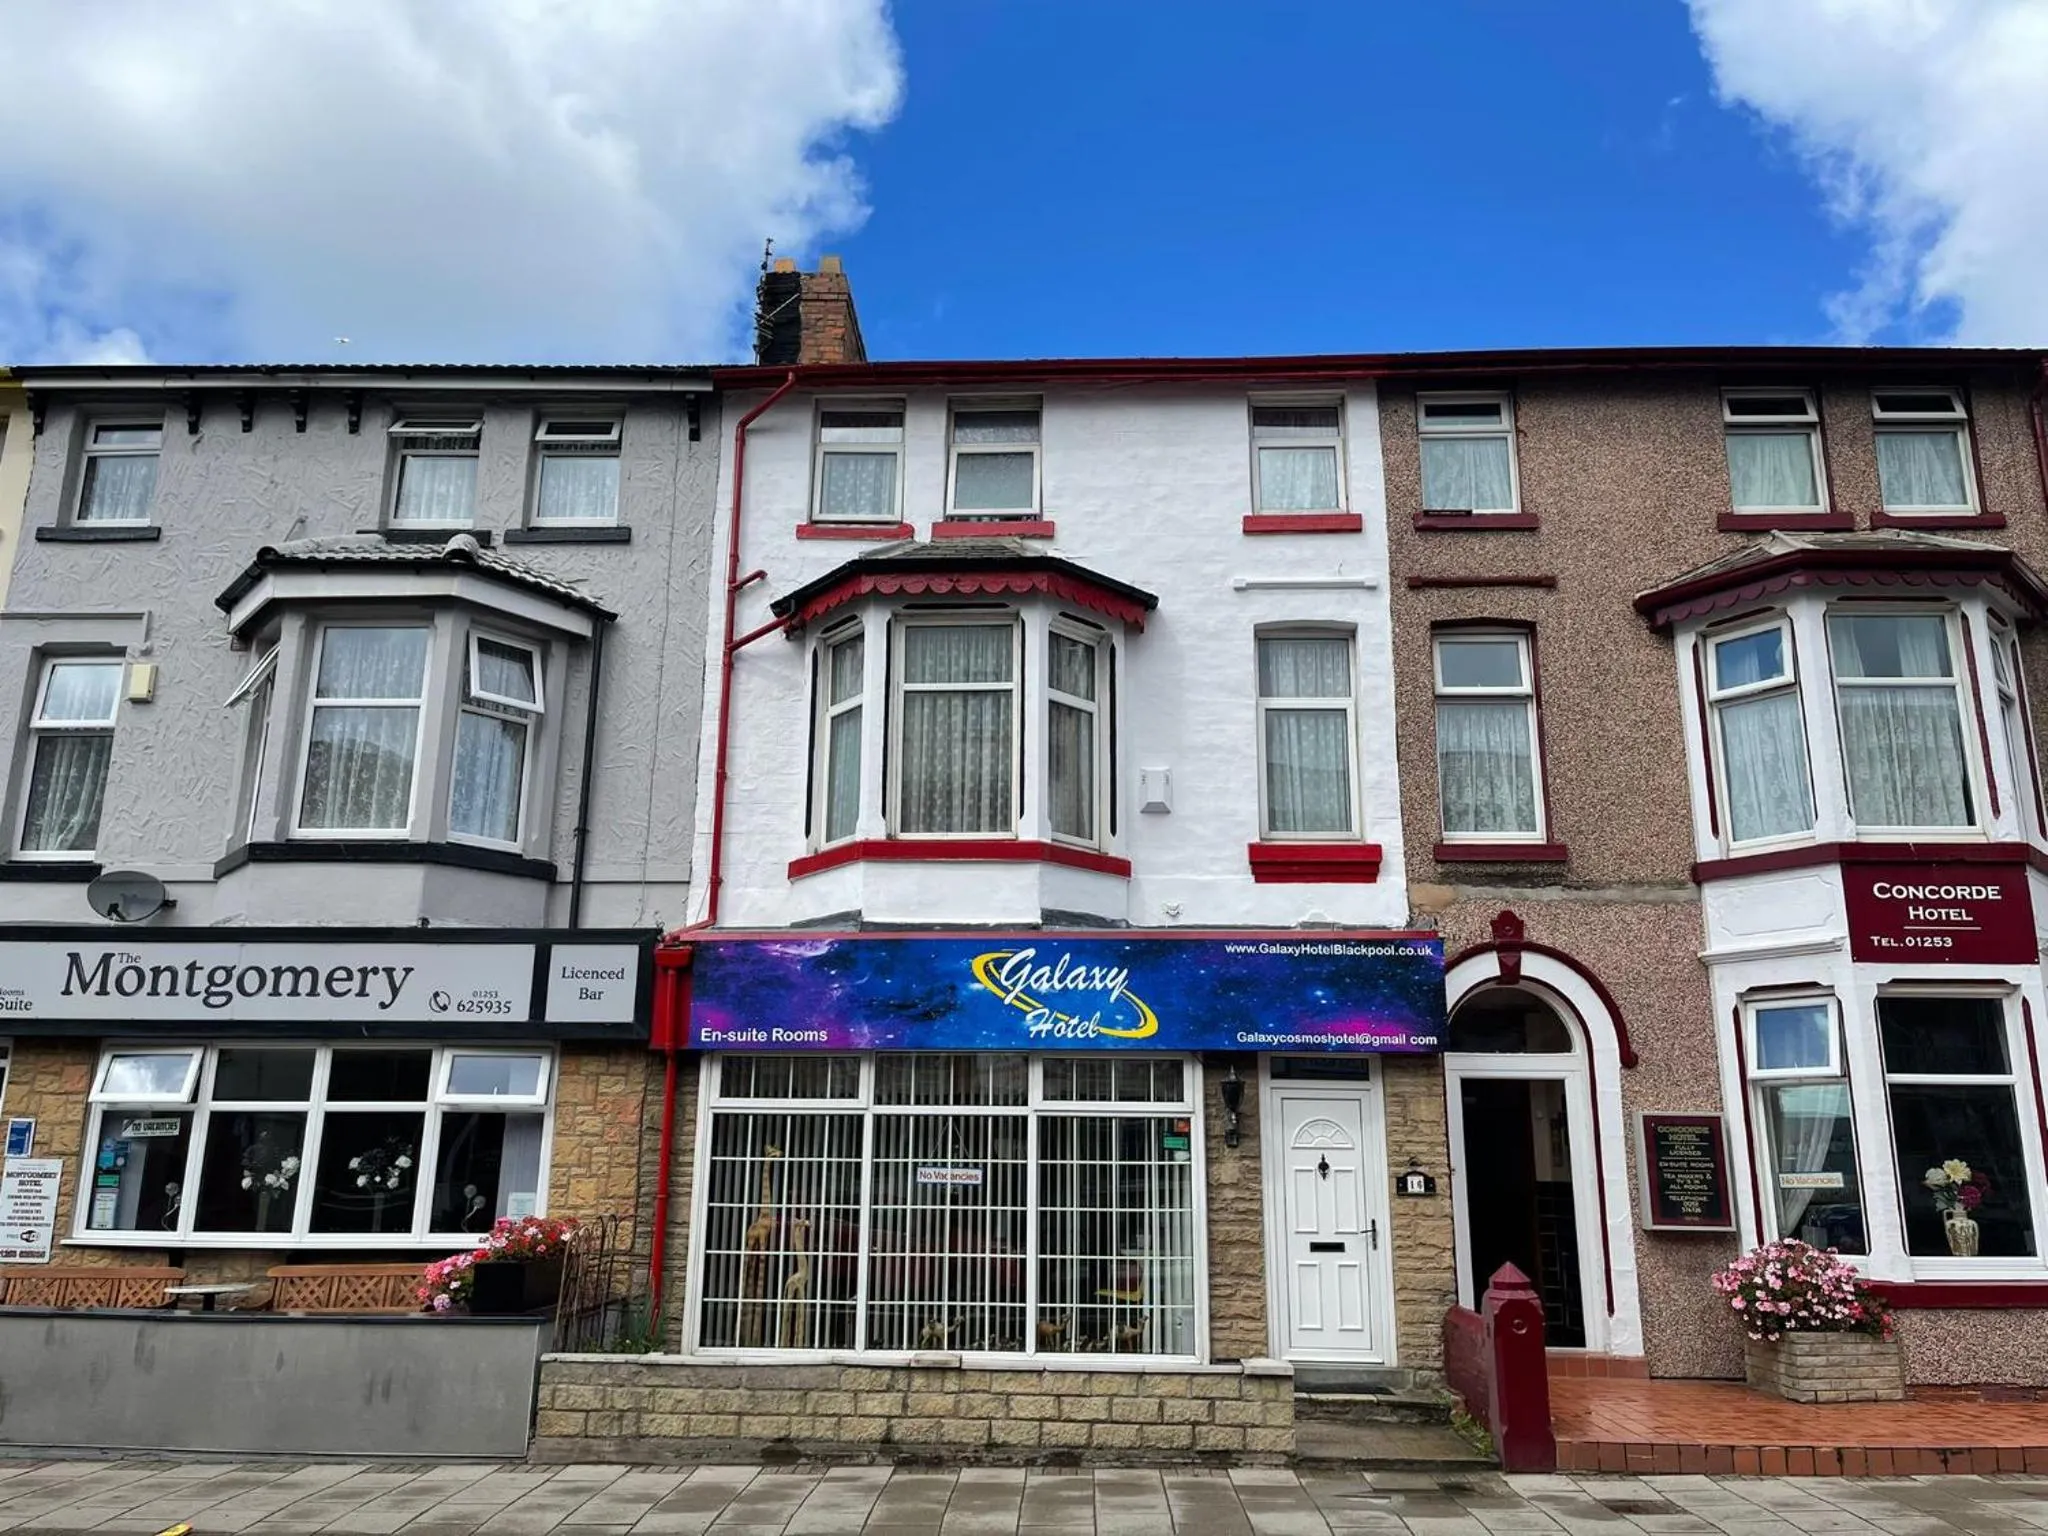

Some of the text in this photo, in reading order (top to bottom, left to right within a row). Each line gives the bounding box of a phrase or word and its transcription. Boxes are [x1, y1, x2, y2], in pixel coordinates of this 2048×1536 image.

[1873, 882, 2002, 899] CONCORDE
[1909, 906, 1974, 921] HOTEL
[1225, 943, 1434, 957] www.GalaxyHotelBlackpool.co.uk
[118, 952, 142, 964] The
[561, 966, 626, 980] Licenced
[1000, 948, 1129, 1005] Galaxy
[61, 952, 415, 1010] Montgomery
[472, 990, 499, 999] 01253
[578, 986, 604, 1000] Bar
[456, 1000, 513, 1014] 625935
[1025, 1008, 1101, 1039] Hotel
[700, 1027, 828, 1042] En-suite Rooms
[919, 1170, 932, 1180] No
